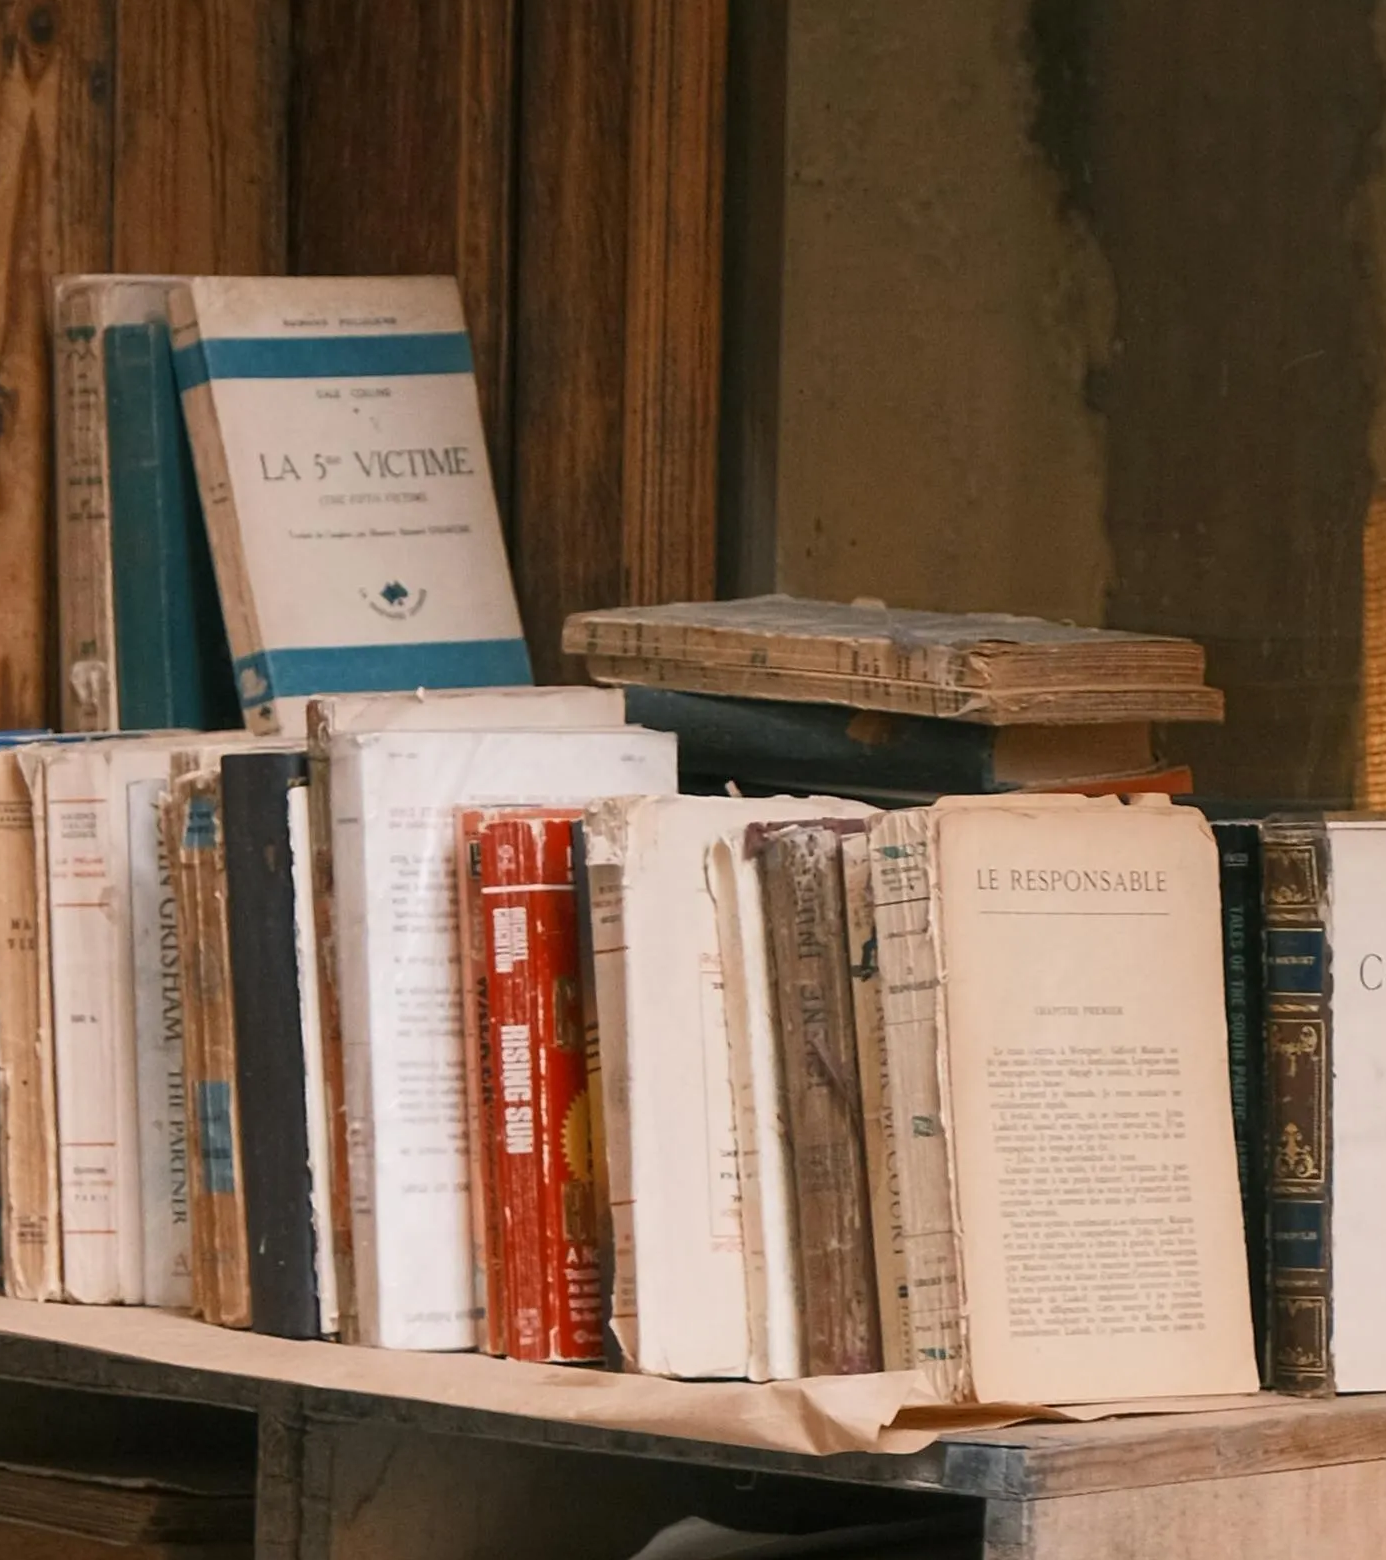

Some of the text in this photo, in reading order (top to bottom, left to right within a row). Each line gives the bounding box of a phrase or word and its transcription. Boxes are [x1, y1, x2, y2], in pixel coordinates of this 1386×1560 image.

[259, 453, 301, 482] LA
[354, 446, 474, 478] VICTIME
[977, 868, 1168, 892] LE RESPONSABLE
[1229, 905, 1244, 949] TALES
[159, 896, 185, 1042] GRISHAM
[1231, 955, 1245, 973] OF
[1231, 978, 1245, 1005] THE
[1233, 1014, 1247, 1060] SOUTH
[501, 1024, 533, 1155] RISING SUN
